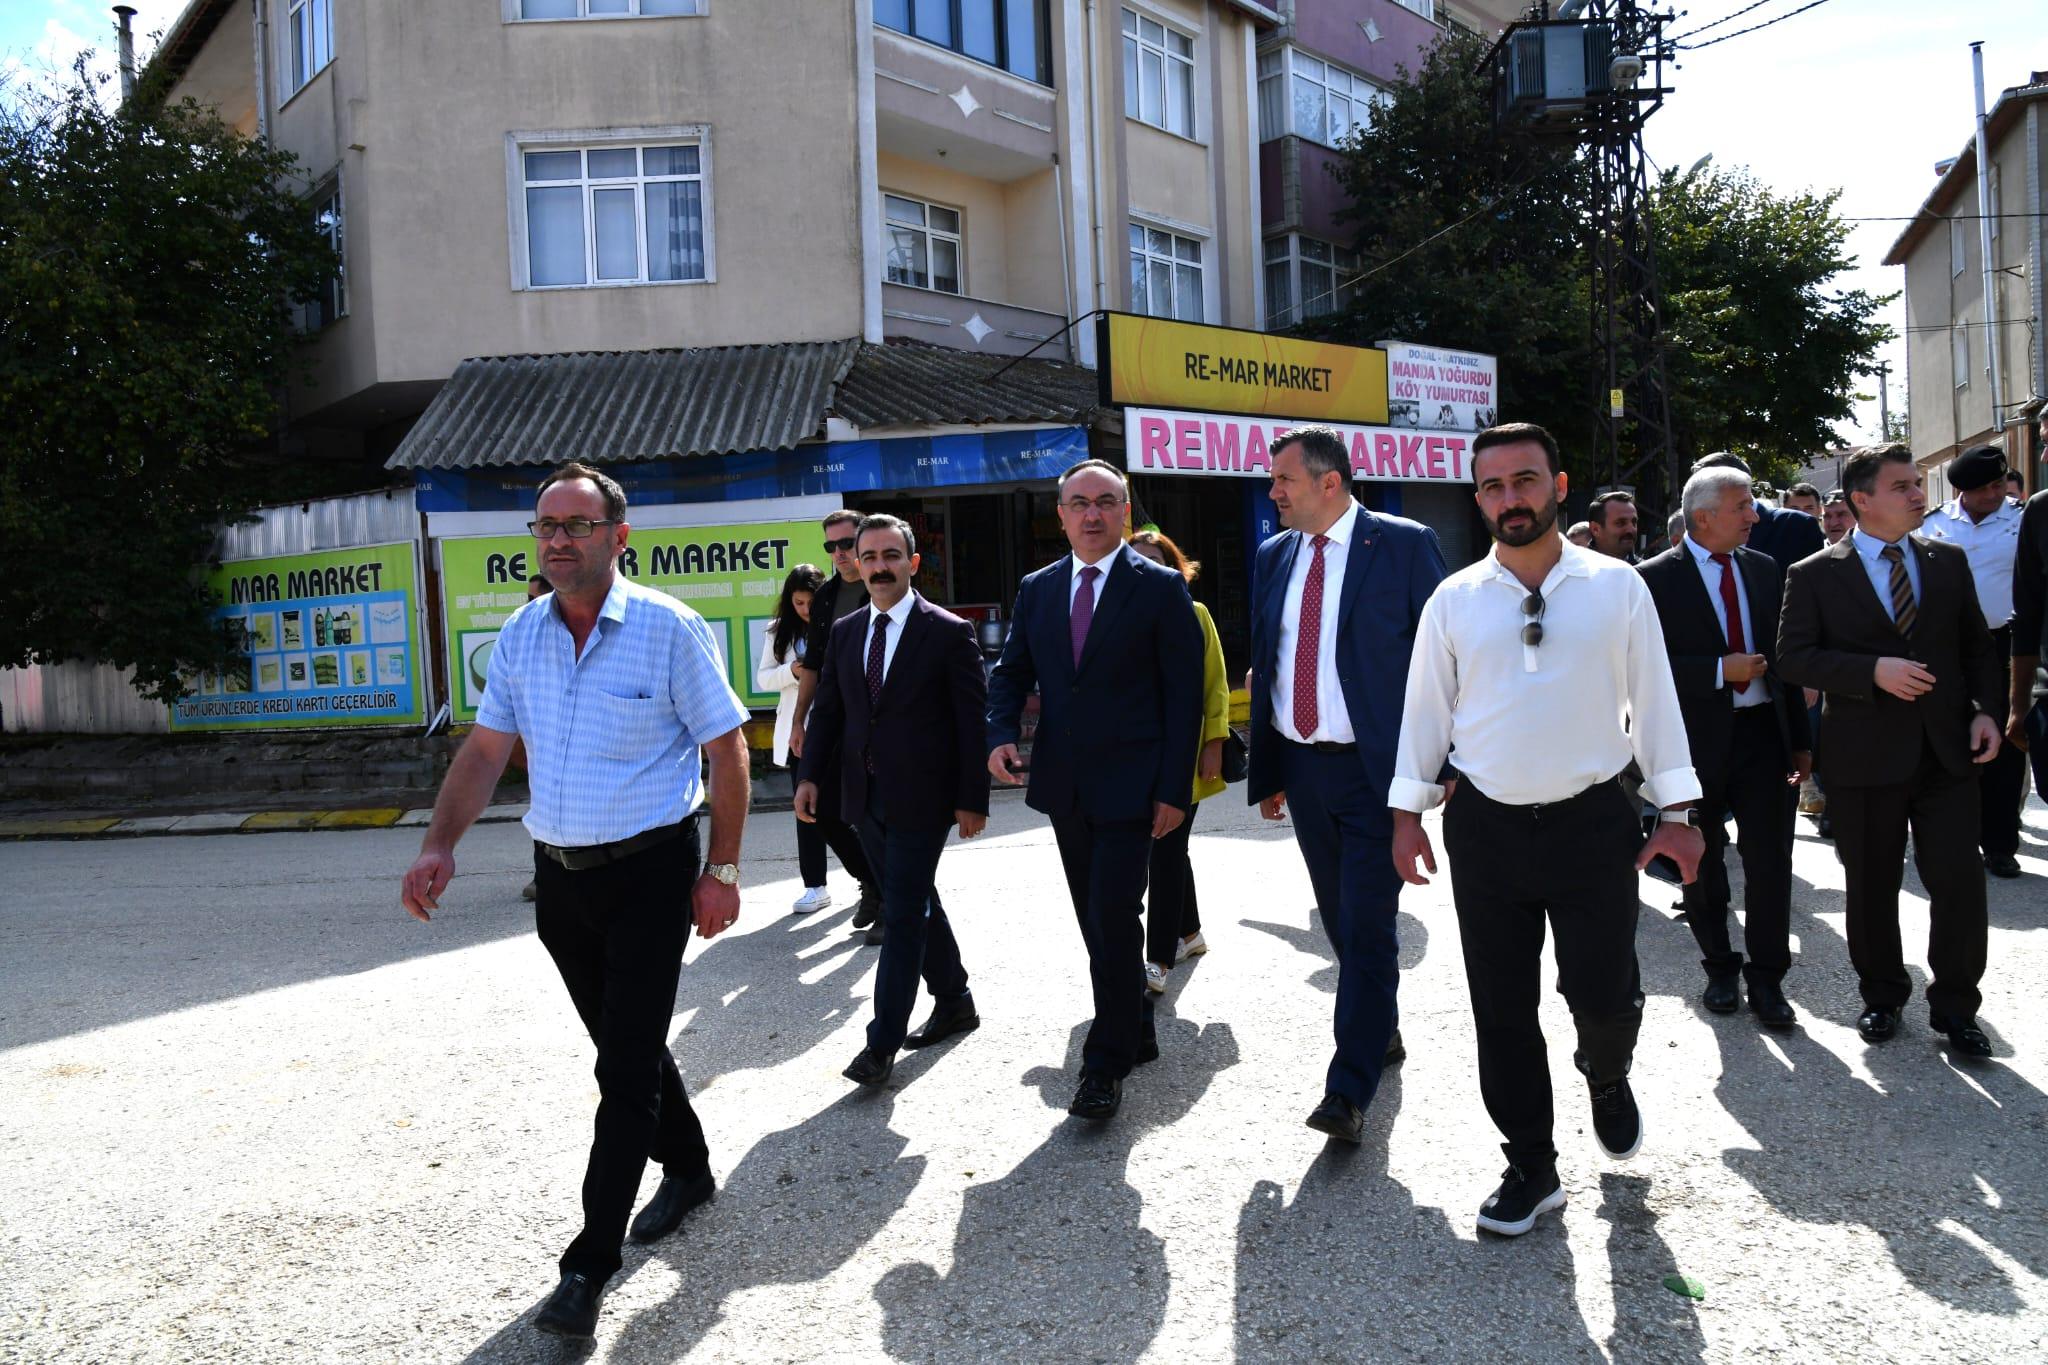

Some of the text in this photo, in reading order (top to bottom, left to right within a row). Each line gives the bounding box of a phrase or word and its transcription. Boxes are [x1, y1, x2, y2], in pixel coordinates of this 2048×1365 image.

[1185, 352, 1332, 392] RE-MAR MARKET
[1392, 361, 1492, 387] MANDA YOĞURDU
[1395, 380, 1490, 406] KÖY YUMURTASI
[917, 456, 949, 466] RE-MAR
[1020, 448, 1052, 459] RE-MAR
[1337, 431, 1467, 479] ARKET
[813, 463, 845, 473] RE-MAR
[650, 539, 789, 576] MARKET
[231, 562, 383, 605] MAR MARKET
[178, 690, 397, 717] TÜM ÜRÜNLERDE KREDİ KARTI GEÇERLİDİR
